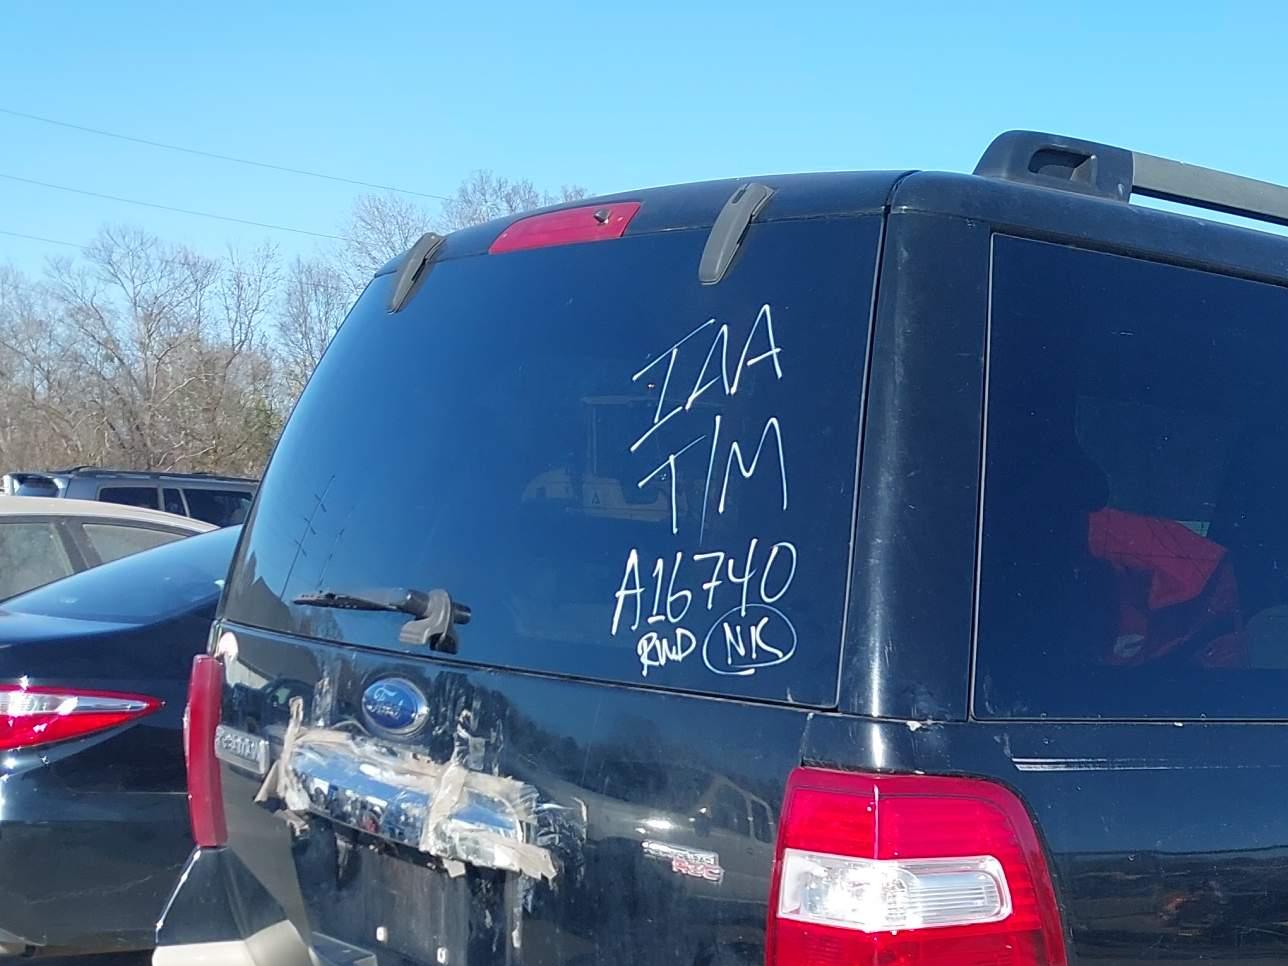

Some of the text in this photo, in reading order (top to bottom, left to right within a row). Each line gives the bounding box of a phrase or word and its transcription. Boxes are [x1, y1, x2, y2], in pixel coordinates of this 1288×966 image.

[631, 303, 783, 453] IAA
[638, 415, 788, 545] T/M
[611, 538, 797, 636] A16740
